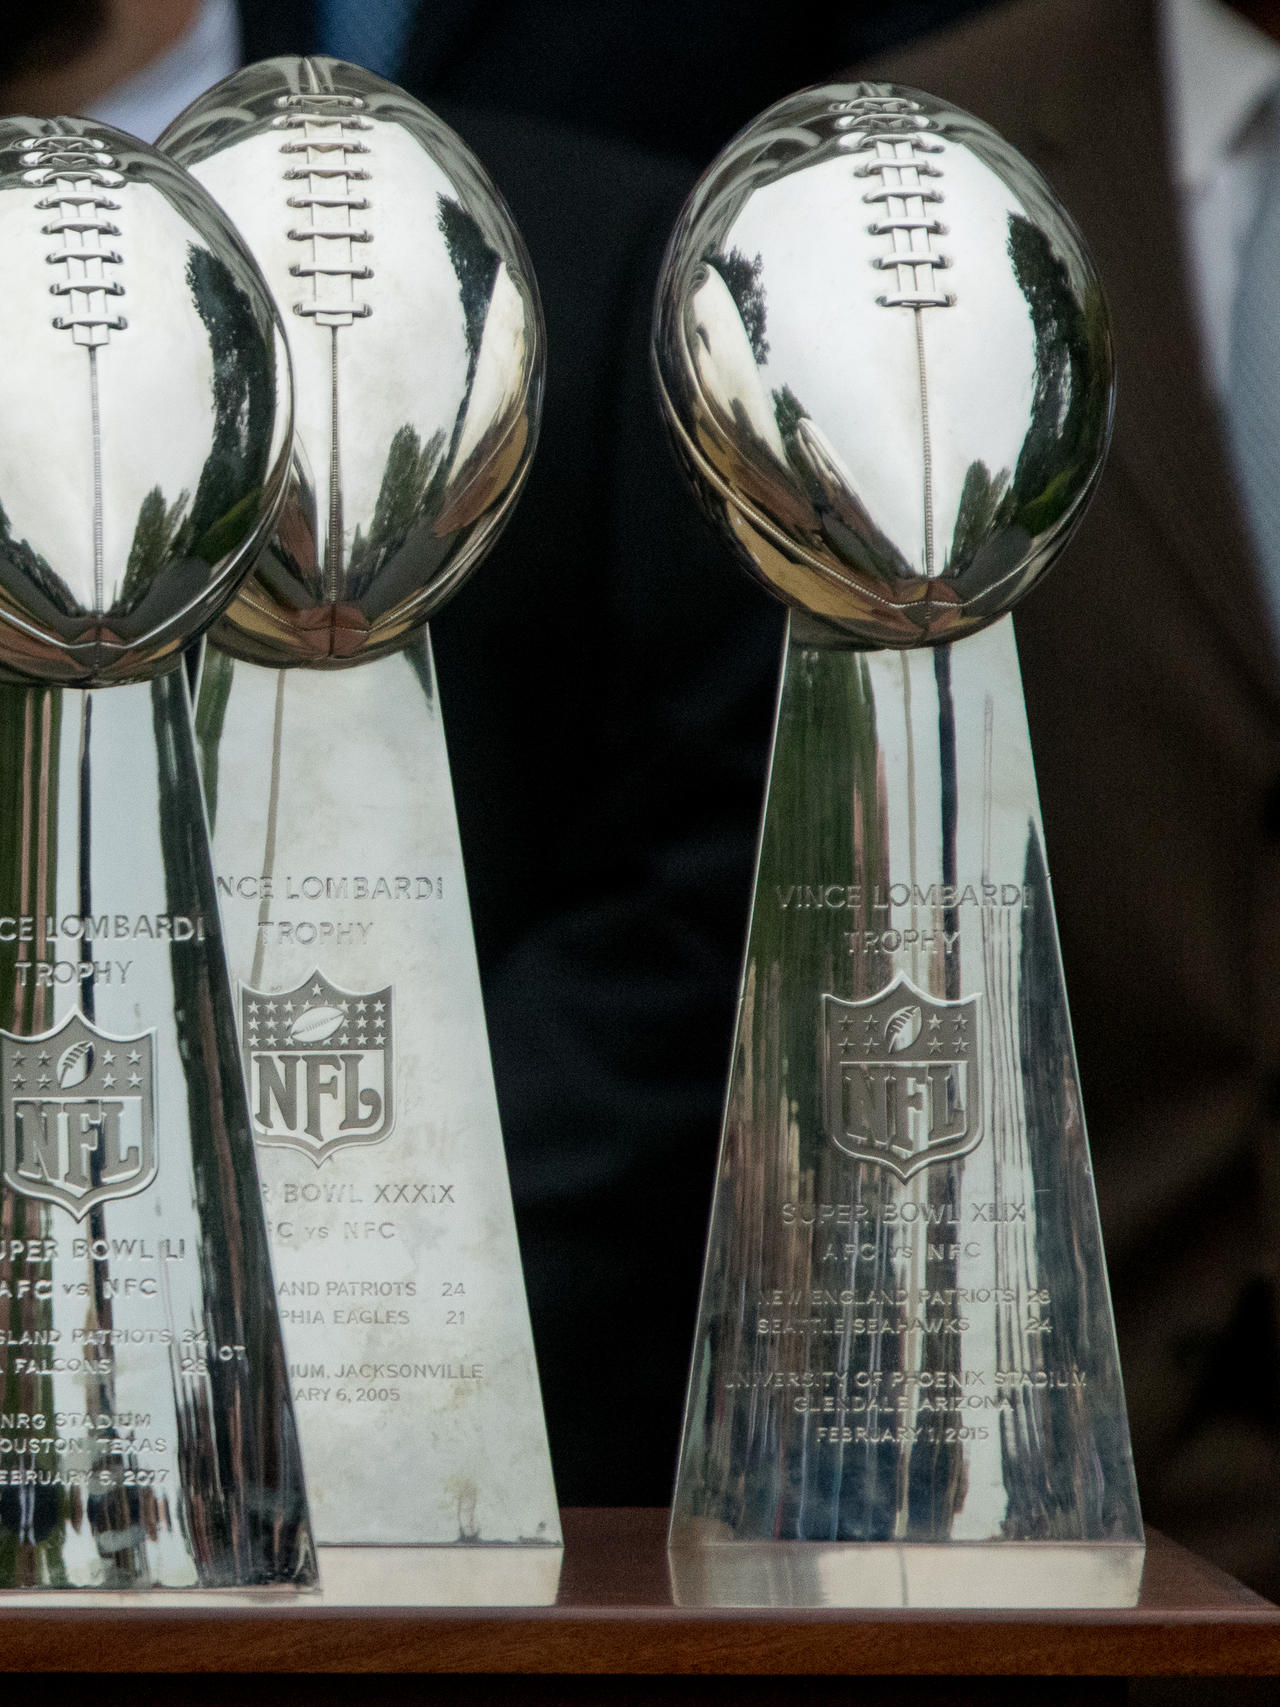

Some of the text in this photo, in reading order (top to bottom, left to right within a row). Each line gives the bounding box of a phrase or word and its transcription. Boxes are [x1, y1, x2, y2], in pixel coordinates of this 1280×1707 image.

[216, 876, 445, 901] NCE LOMBARDI
[775, 883, 1033, 910] VINCE LOMBARDI
[45, 914, 206, 942] LOMBARDI
[257, 920, 375, 946] TROPHY
[843, 929, 961, 954] TROPHY
[14, 960, 134, 987] TROPHY
[251, 1054, 383, 1142] NFL
[842, 1064, 967, 1153] NFL
[15, 1101, 140, 1190] NFL
[283, 1182, 364, 1204] BOWL
[373, 1183, 456, 1205] XXXIX
[780, 1202, 1027, 1225] SUPER BOWL XLIX
[343, 1221, 397, 1240] NFC
[72, 1238, 154, 1262] BOWL
[164, 1238, 186, 1262] LI
[822, 1242, 877, 1262] AFC
[928, 1241, 982, 1261] NFC
[102, 1278, 158, 1299] NFC
[326, 1281, 418, 1298] PATRIOTS
[441, 1282, 467, 1298] 24
[756, 1289, 801, 1306] NEW
[810, 1289, 910, 1306] ENGLAND
[920, 1288, 1017, 1305] PATRIOTS
[333, 1310, 411, 1326] EAGLES
[444, 1310, 466, 1326] 21
[756, 1317, 1053, 1335] SEATTLE SEAHAWKS 24
[71, 1328, 173, 1345] PATRIOTS
[219, 1345, 247, 1361] OT
[14, 1357, 112, 1375] FALCONS
[334, 1363, 485, 1380] JACKSONVILLE
[853, 1371, 884, 1389] OF
[890, 1371, 986, 1389] PHOENIX
[994, 1371, 1087, 1389] STADIUM
[335, 1387, 353, 1404] 6,
[355, 1387, 401, 1402] 2005
[918, 1394, 1015, 1413] ARIZONA
[1, 1411, 152, 1431] NRG STADIUM
[816, 1426, 925, 1443] FEBRUARY
[944, 1426, 990, 1444] 2015
[97, 1437, 169, 1454] TEXAS
[123, 1468, 171, 1487] 2017
